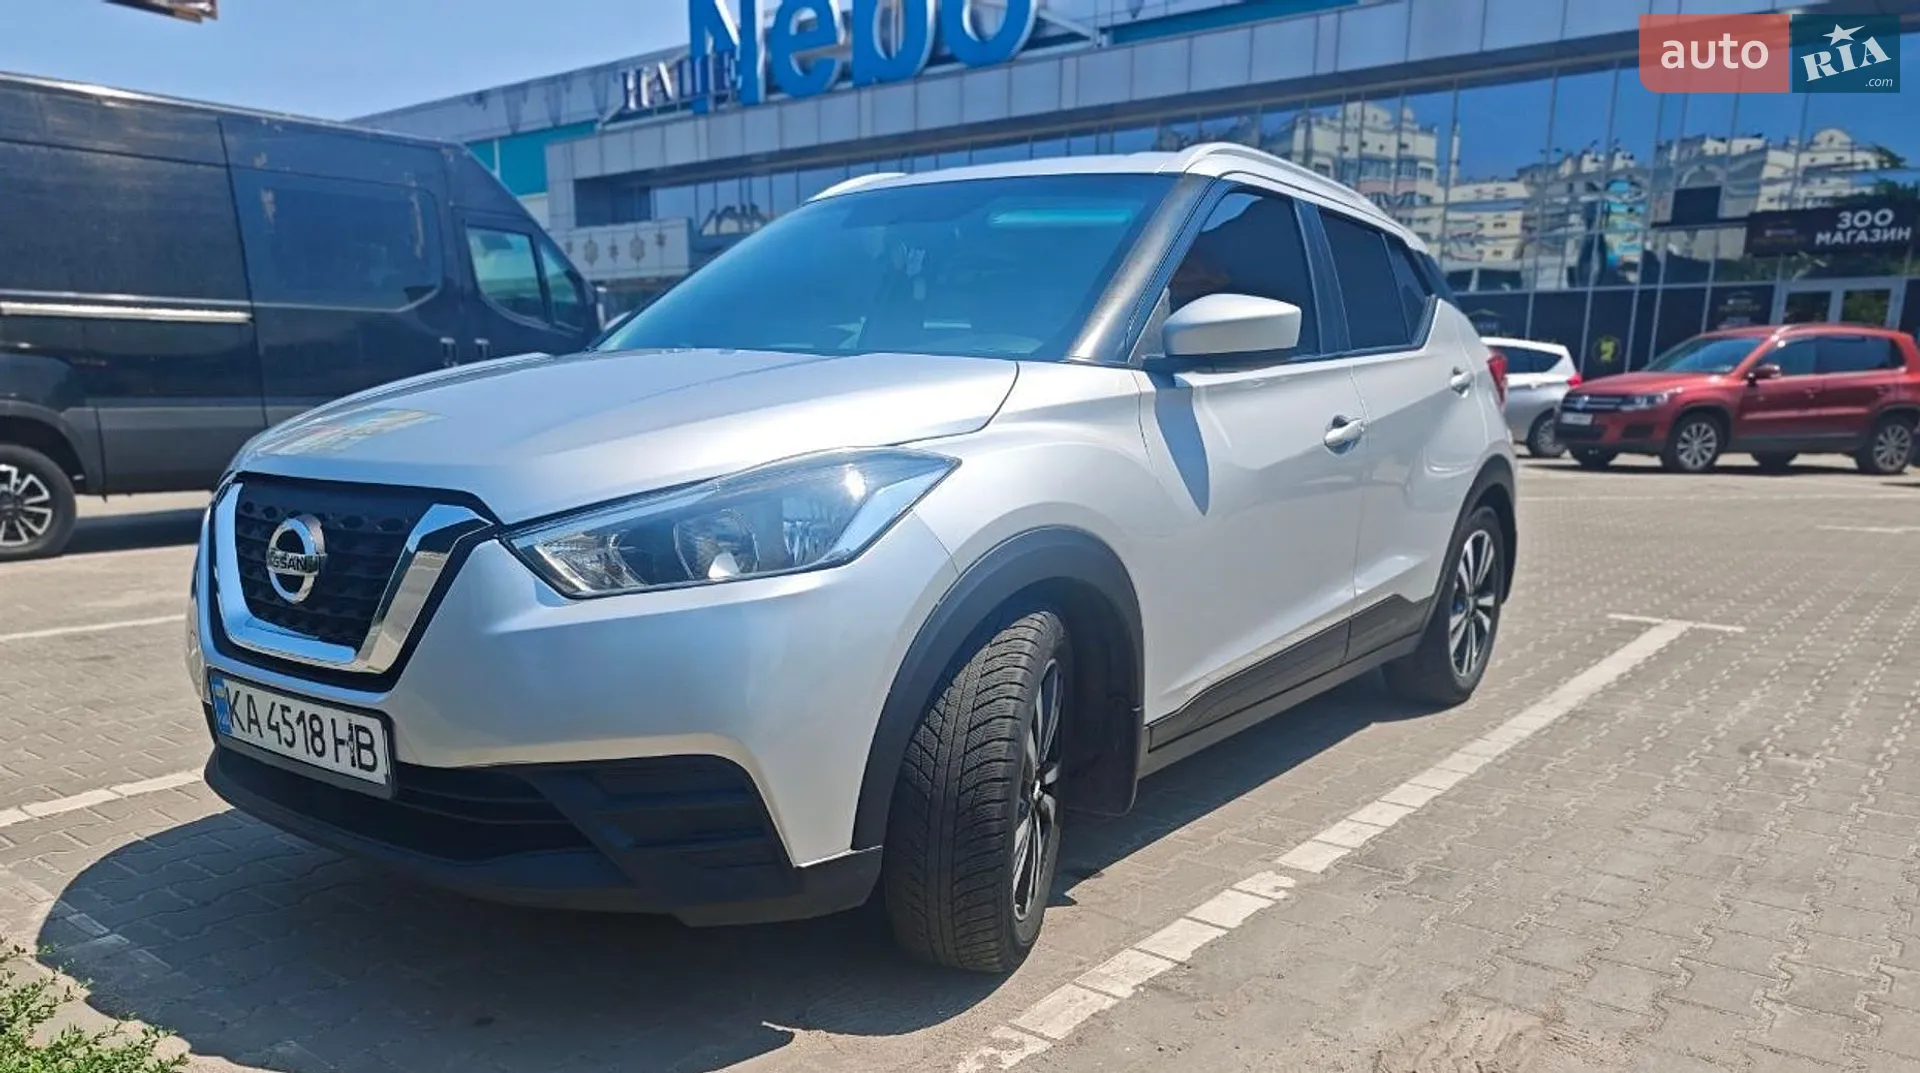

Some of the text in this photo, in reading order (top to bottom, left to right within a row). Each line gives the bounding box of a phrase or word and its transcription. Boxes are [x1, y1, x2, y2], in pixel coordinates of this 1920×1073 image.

[1836, 208, 1895, 230] ЗОО
[1815, 226, 1912, 246] МАГАЗИН
[269, 551, 307, 571] SSAN
[226, 687, 378, 772] KA 4518 HB
